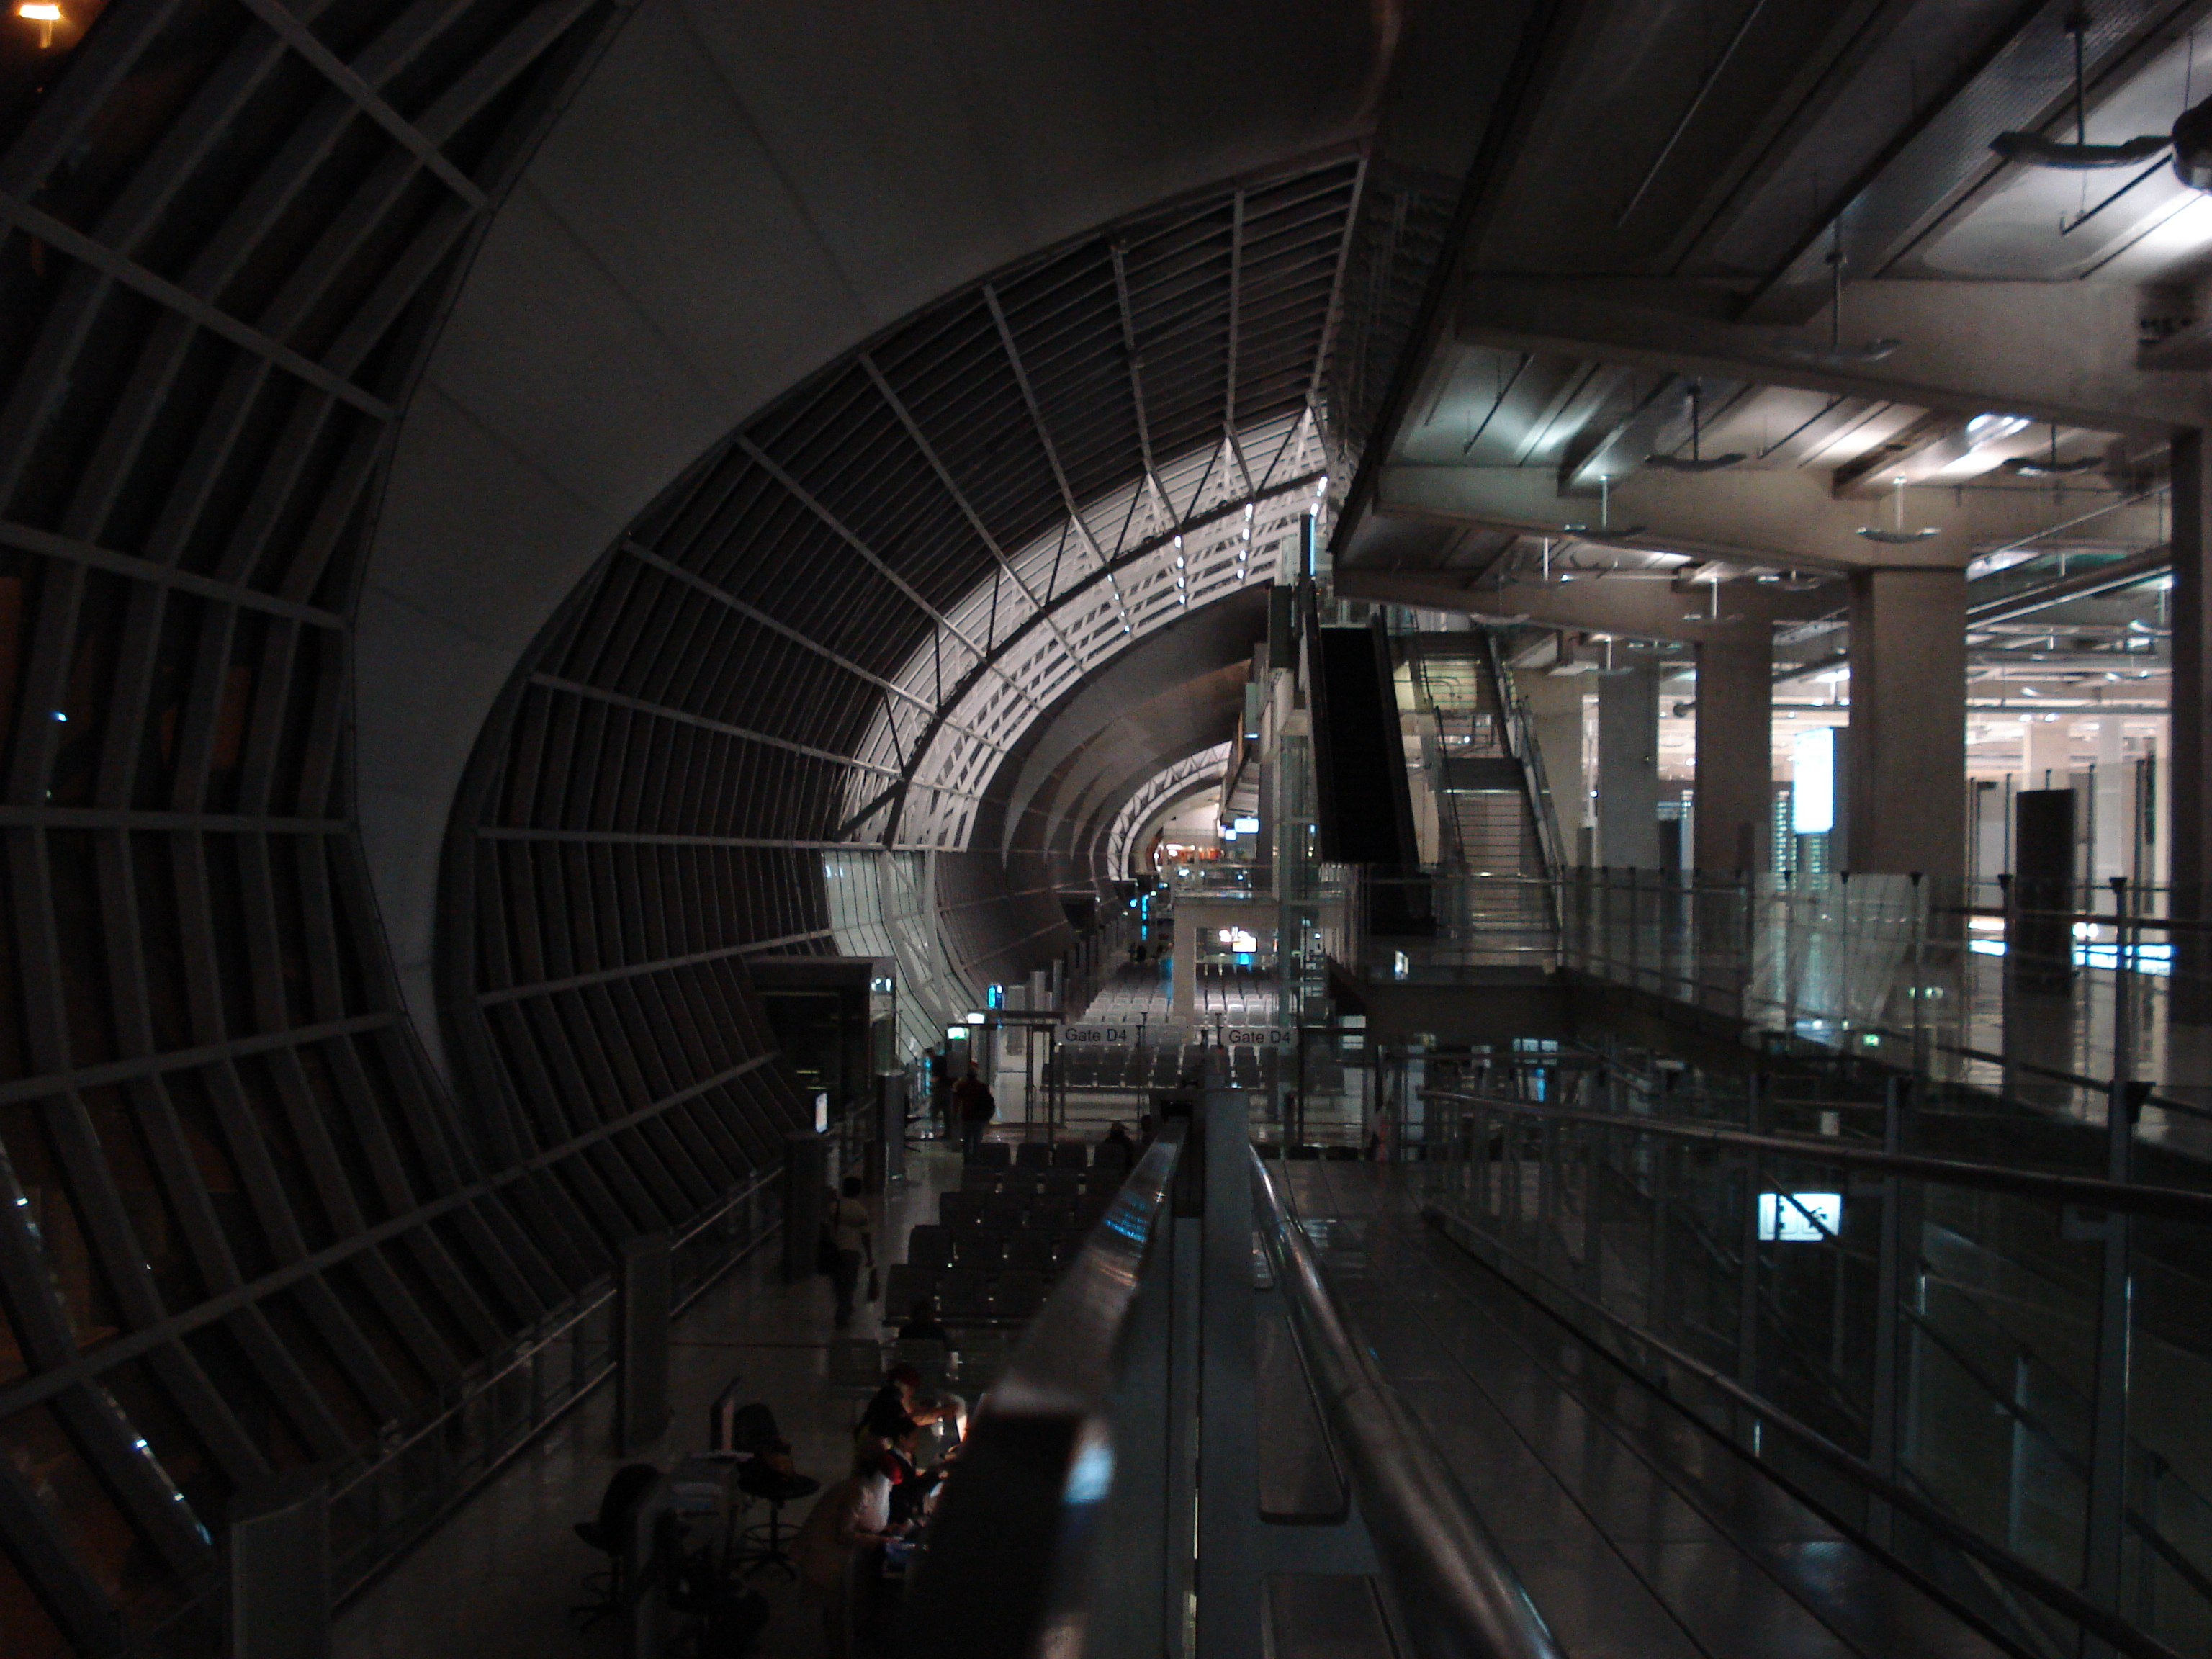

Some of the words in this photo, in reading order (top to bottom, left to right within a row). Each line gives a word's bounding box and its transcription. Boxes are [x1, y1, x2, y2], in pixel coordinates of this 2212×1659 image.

[1065, 1028, 1101, 1042] Gate
[1107, 1028, 1127, 1042] D4
[1228, 1030, 1264, 1043] Gate
[1270, 1030, 1290, 1043] D4
